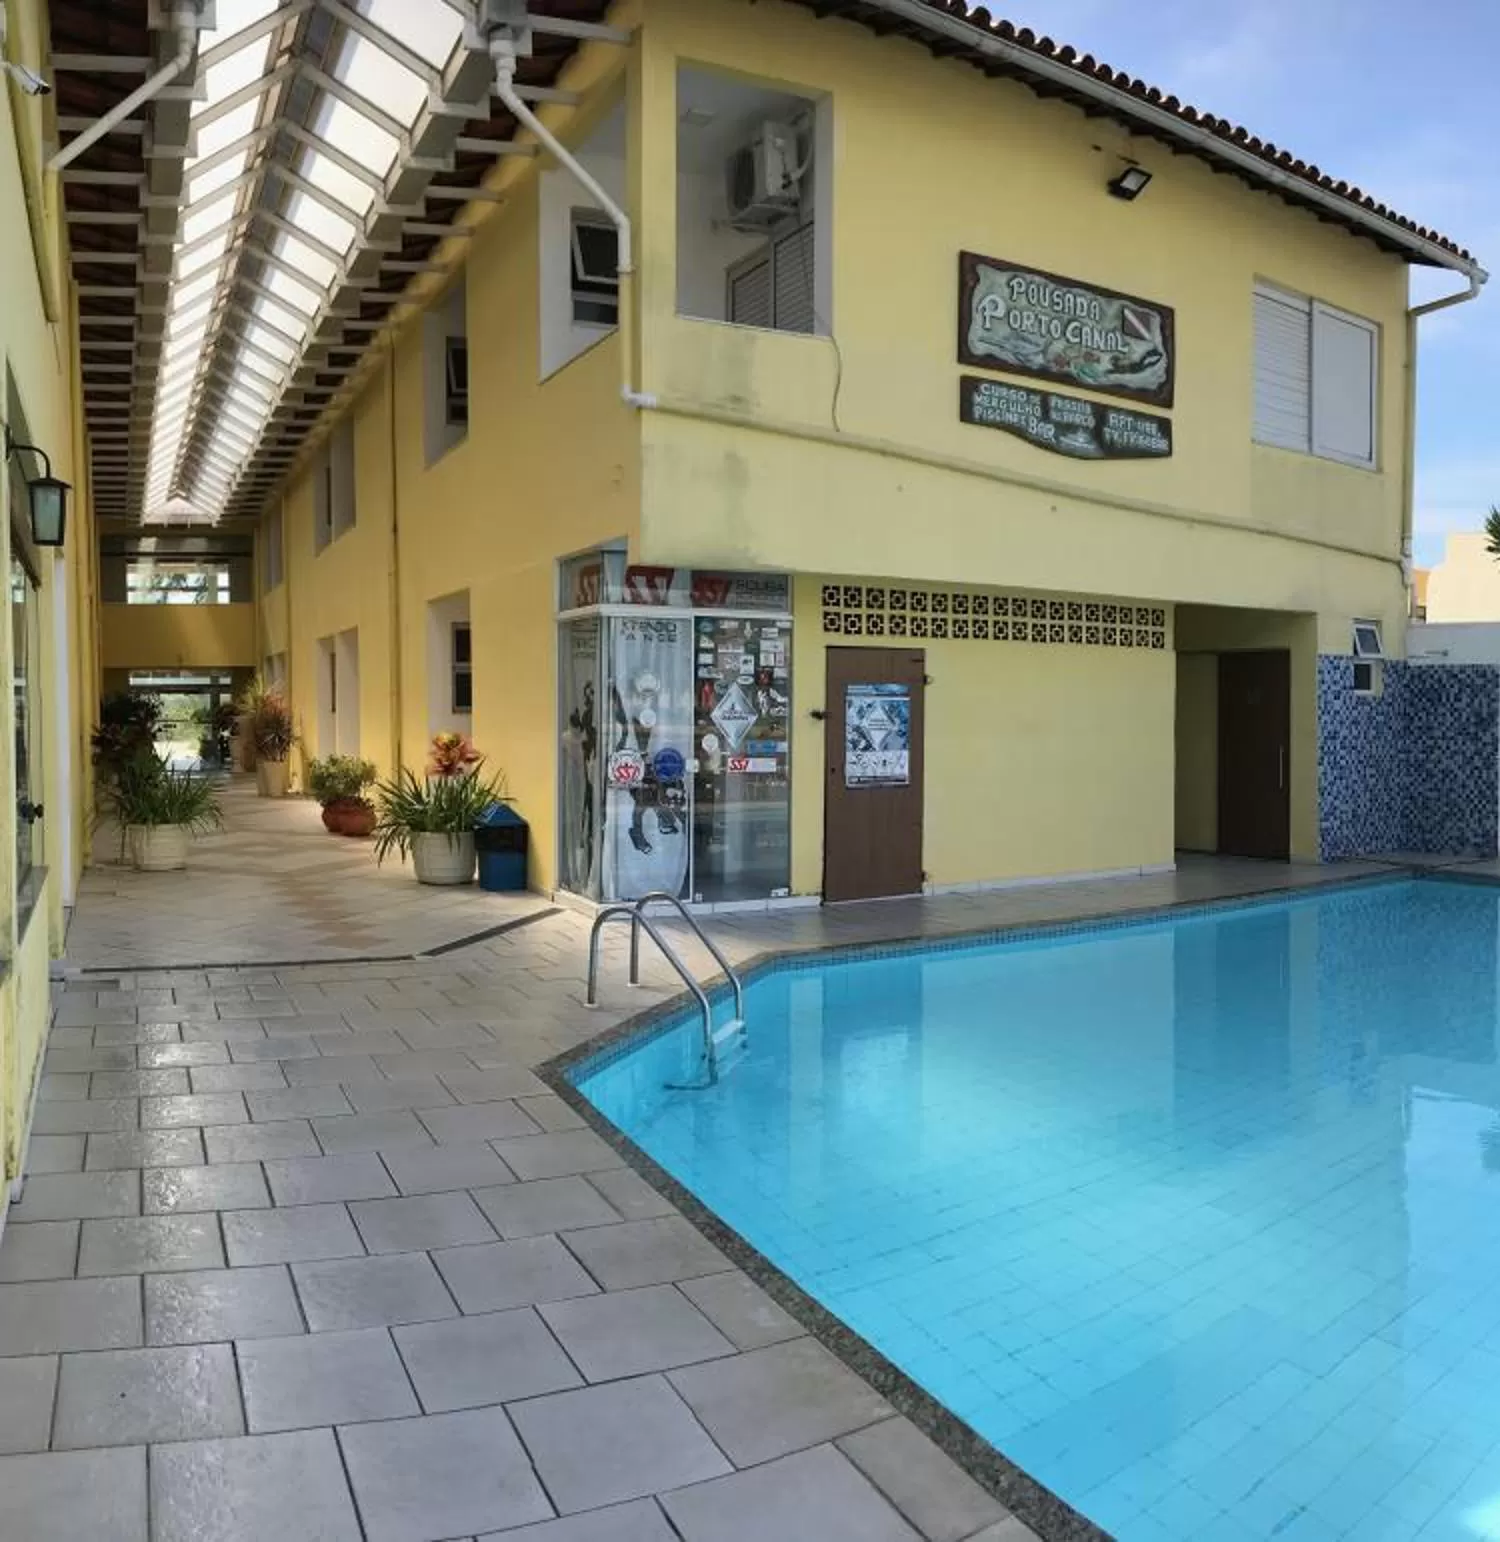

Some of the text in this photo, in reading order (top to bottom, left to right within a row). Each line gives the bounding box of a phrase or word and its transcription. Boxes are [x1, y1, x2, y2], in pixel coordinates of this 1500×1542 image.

[1009, 277, 1100, 321] POUSADA
[978, 294, 1129, 353] PORTO CANAL
[973, 391, 1041, 418] MERGULHO
